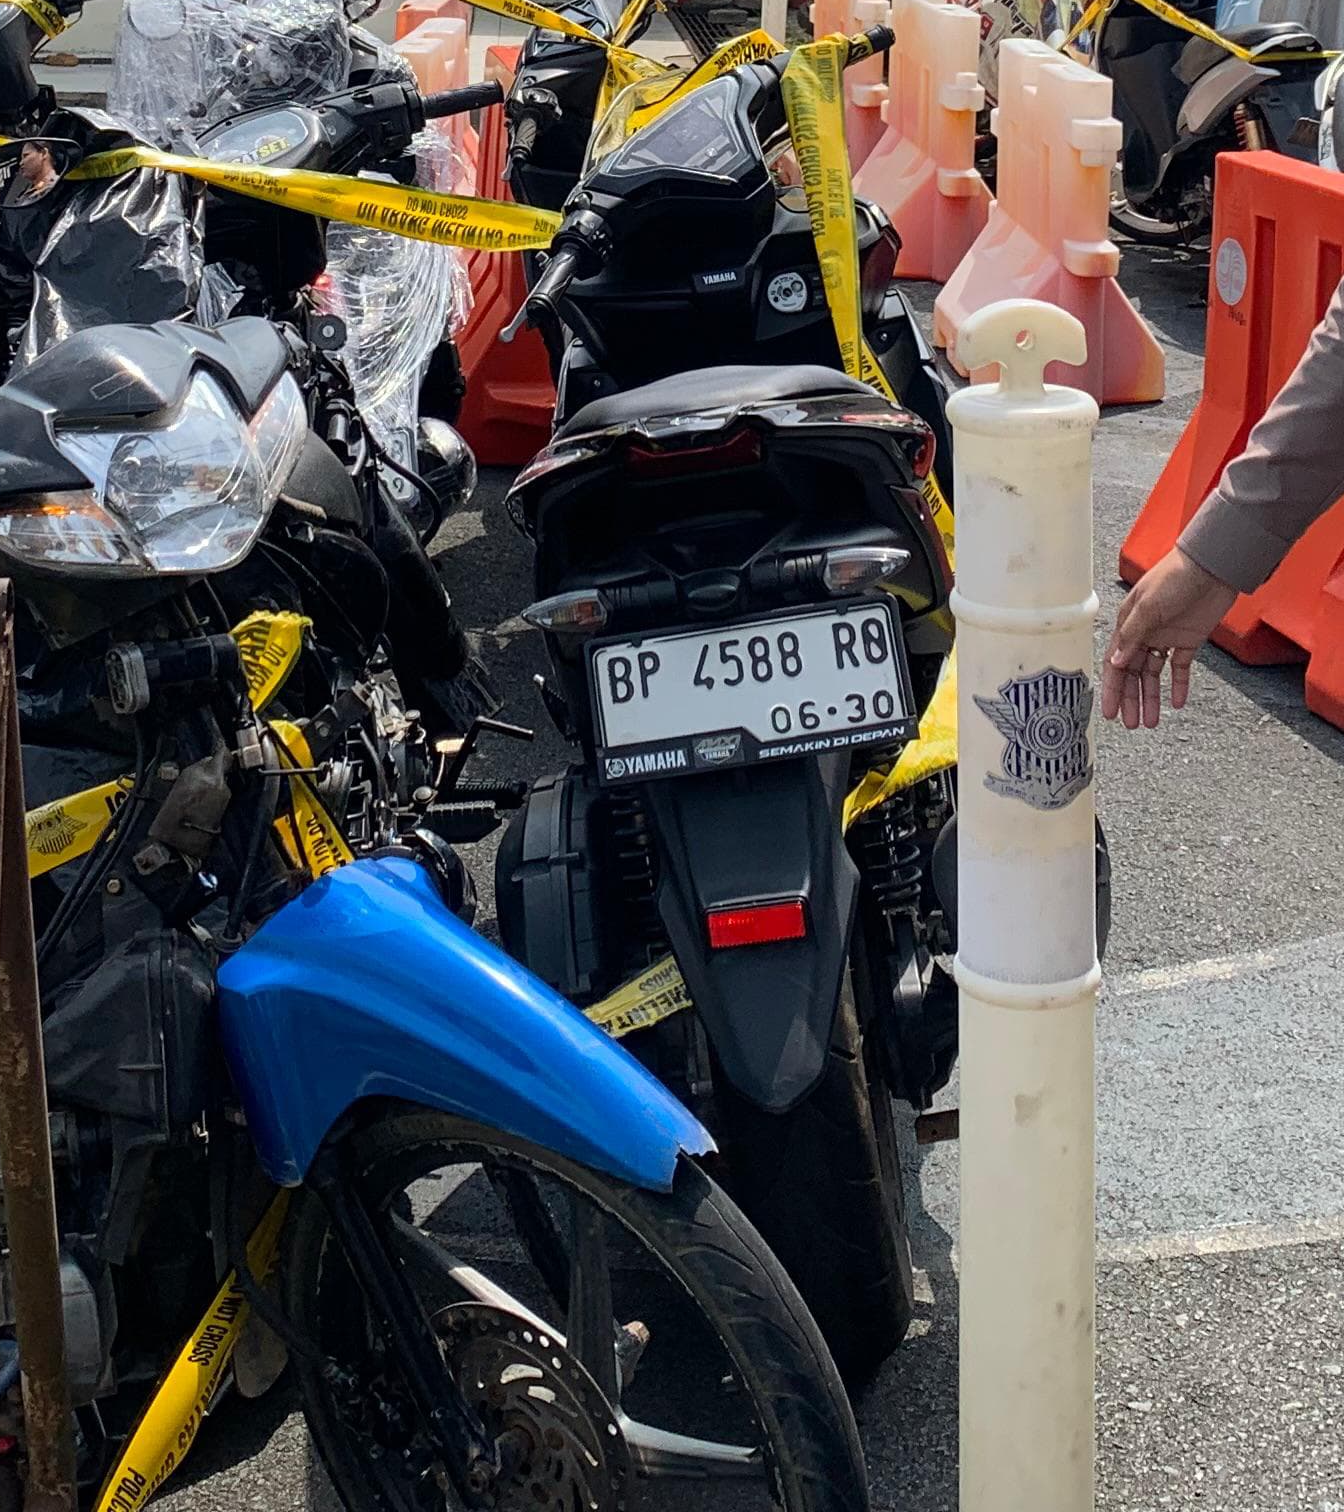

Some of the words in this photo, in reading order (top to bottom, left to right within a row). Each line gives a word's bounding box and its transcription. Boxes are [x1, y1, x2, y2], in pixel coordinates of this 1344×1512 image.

[703, 272, 738, 285] YAMAHA
[608, 651, 662, 704] BP
[692, 631, 804, 691] 4588
[759, 739, 831, 759] SEMAKIN
[833, 735, 853, 747] DI
[854, 726, 905, 745] DEPAN
[625, 749, 687, 775] YAMAHA
[212, 1296, 245, 1324] NOT
[188, 1323, 229, 1367] CROSS
